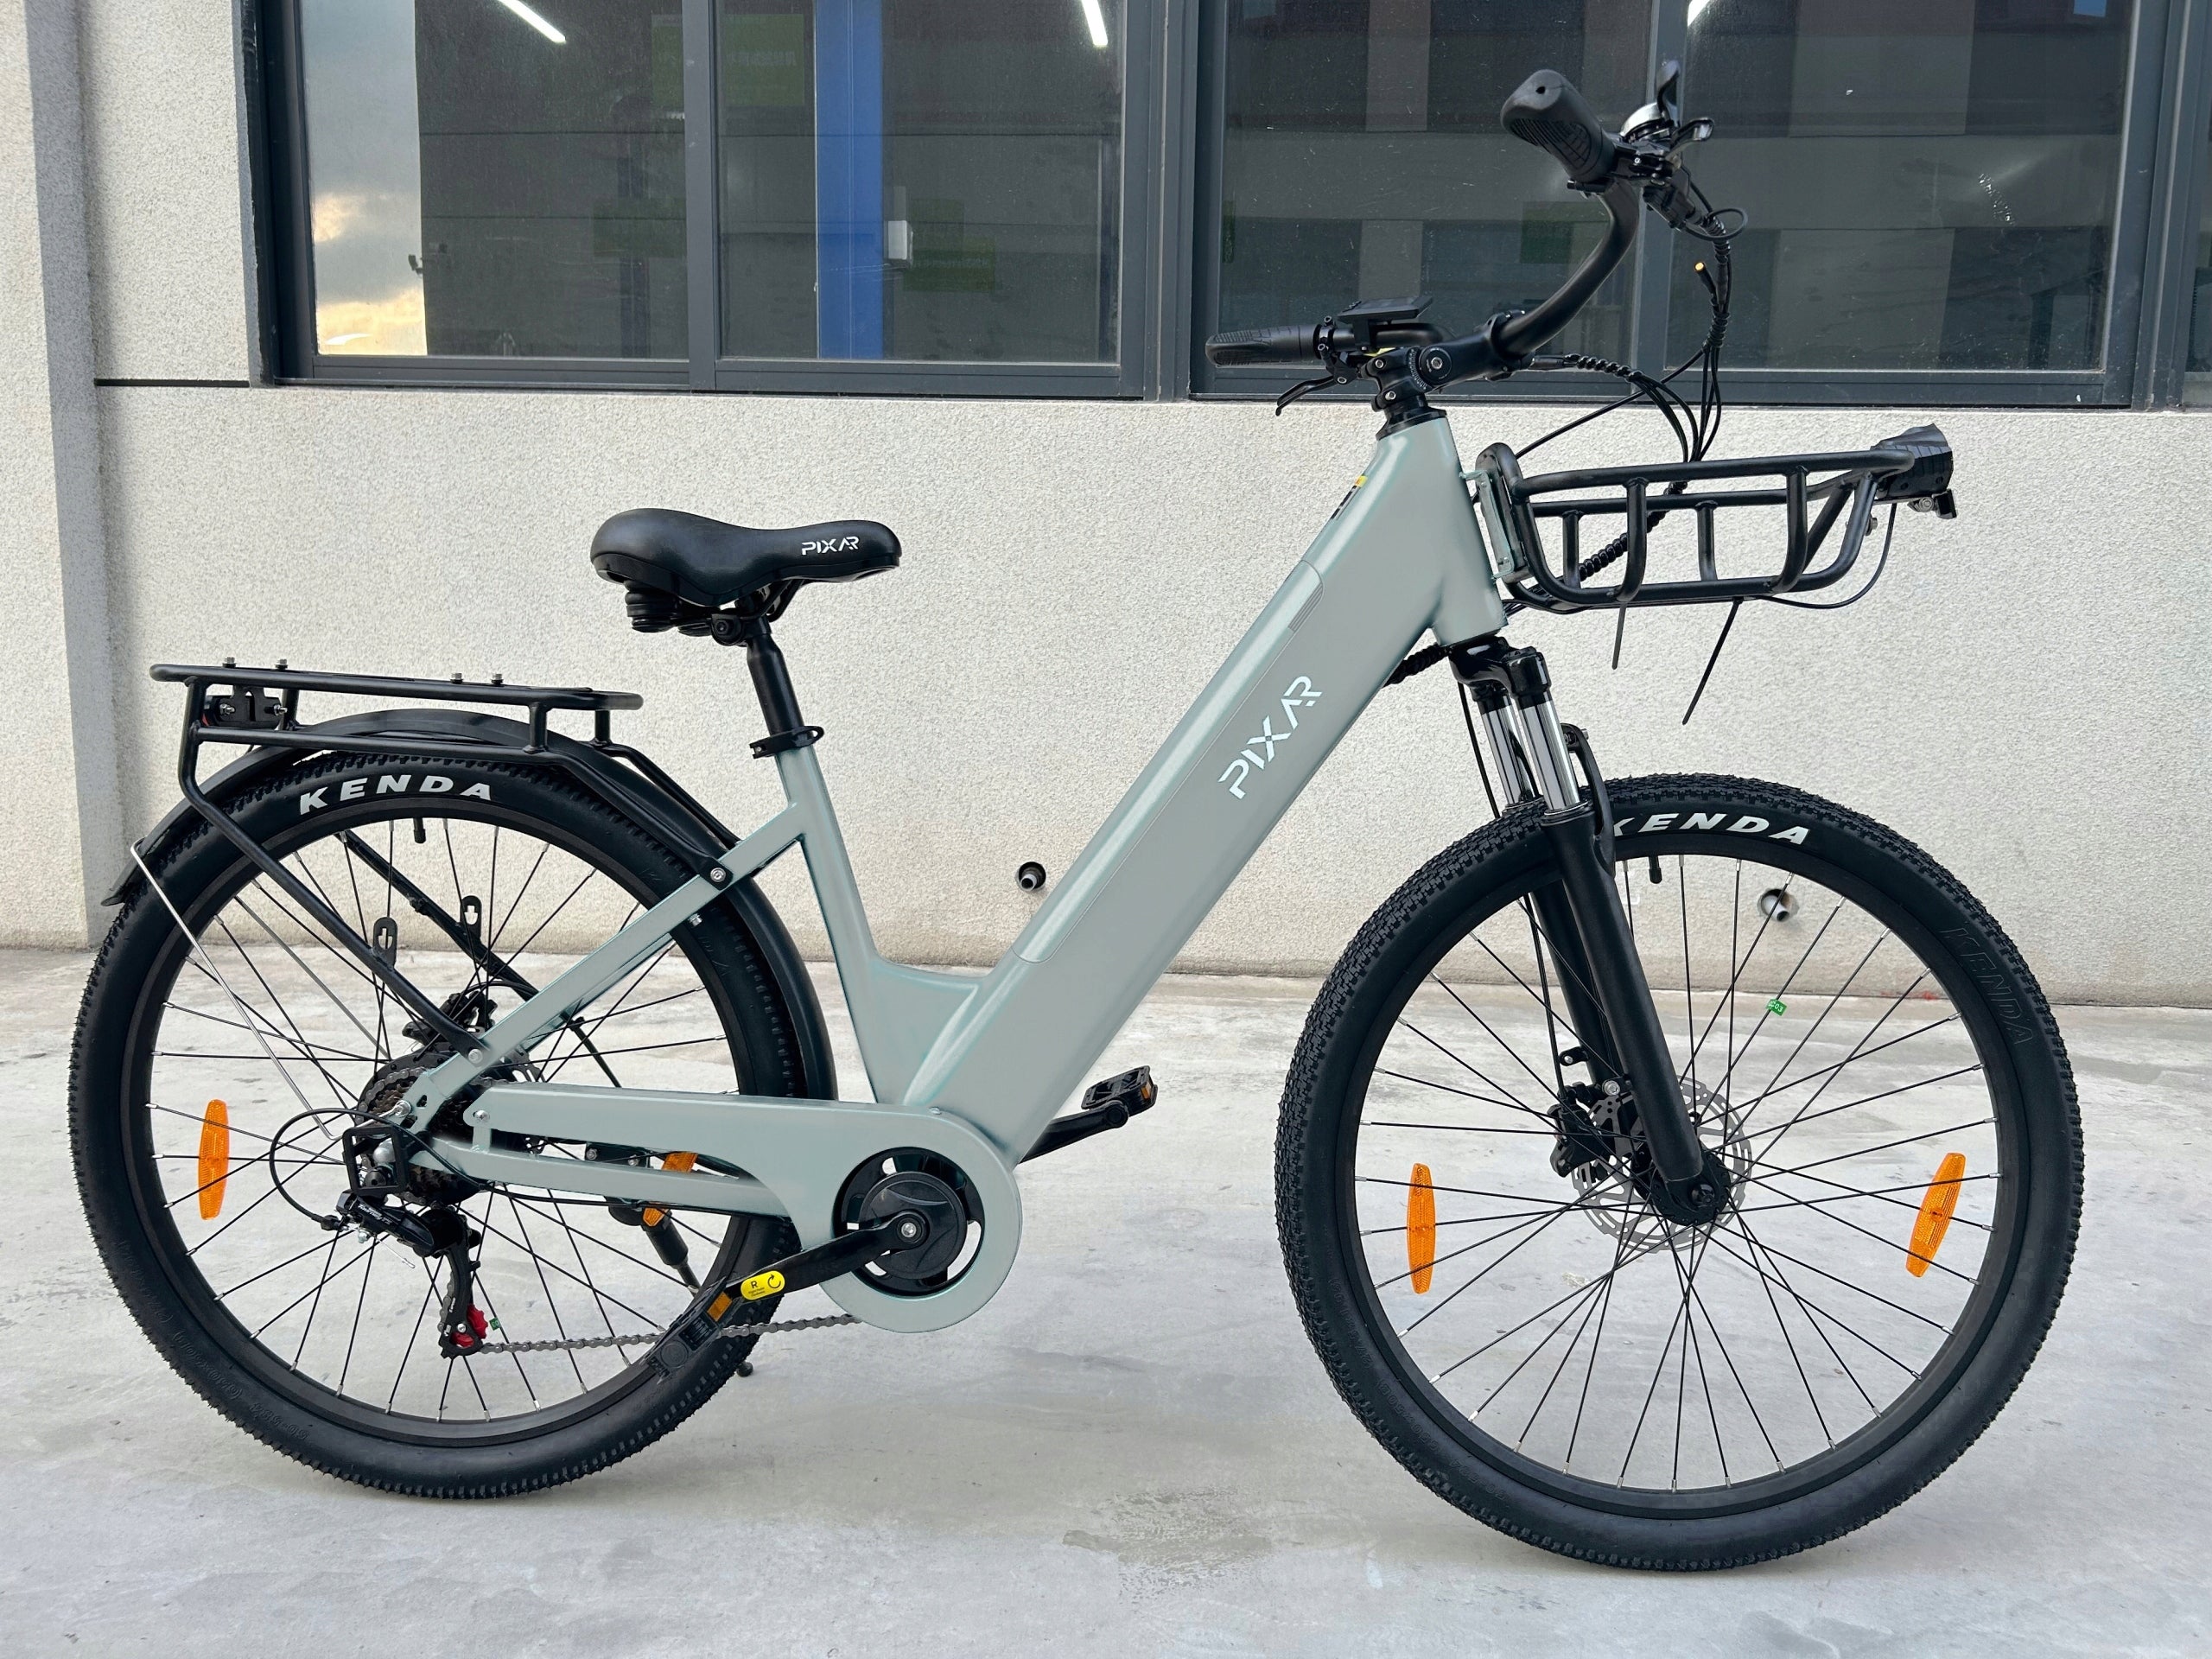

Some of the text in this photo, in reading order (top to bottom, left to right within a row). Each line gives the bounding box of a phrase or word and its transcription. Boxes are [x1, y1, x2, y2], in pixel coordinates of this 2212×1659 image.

[801, 536, 860, 556] PIXAR
[1217, 676, 1323, 799] PIXAR
[299, 774, 492, 816] KENDA
[1939, 927, 2033, 1045] KENDA
[750, 1281, 758, 1289] R
